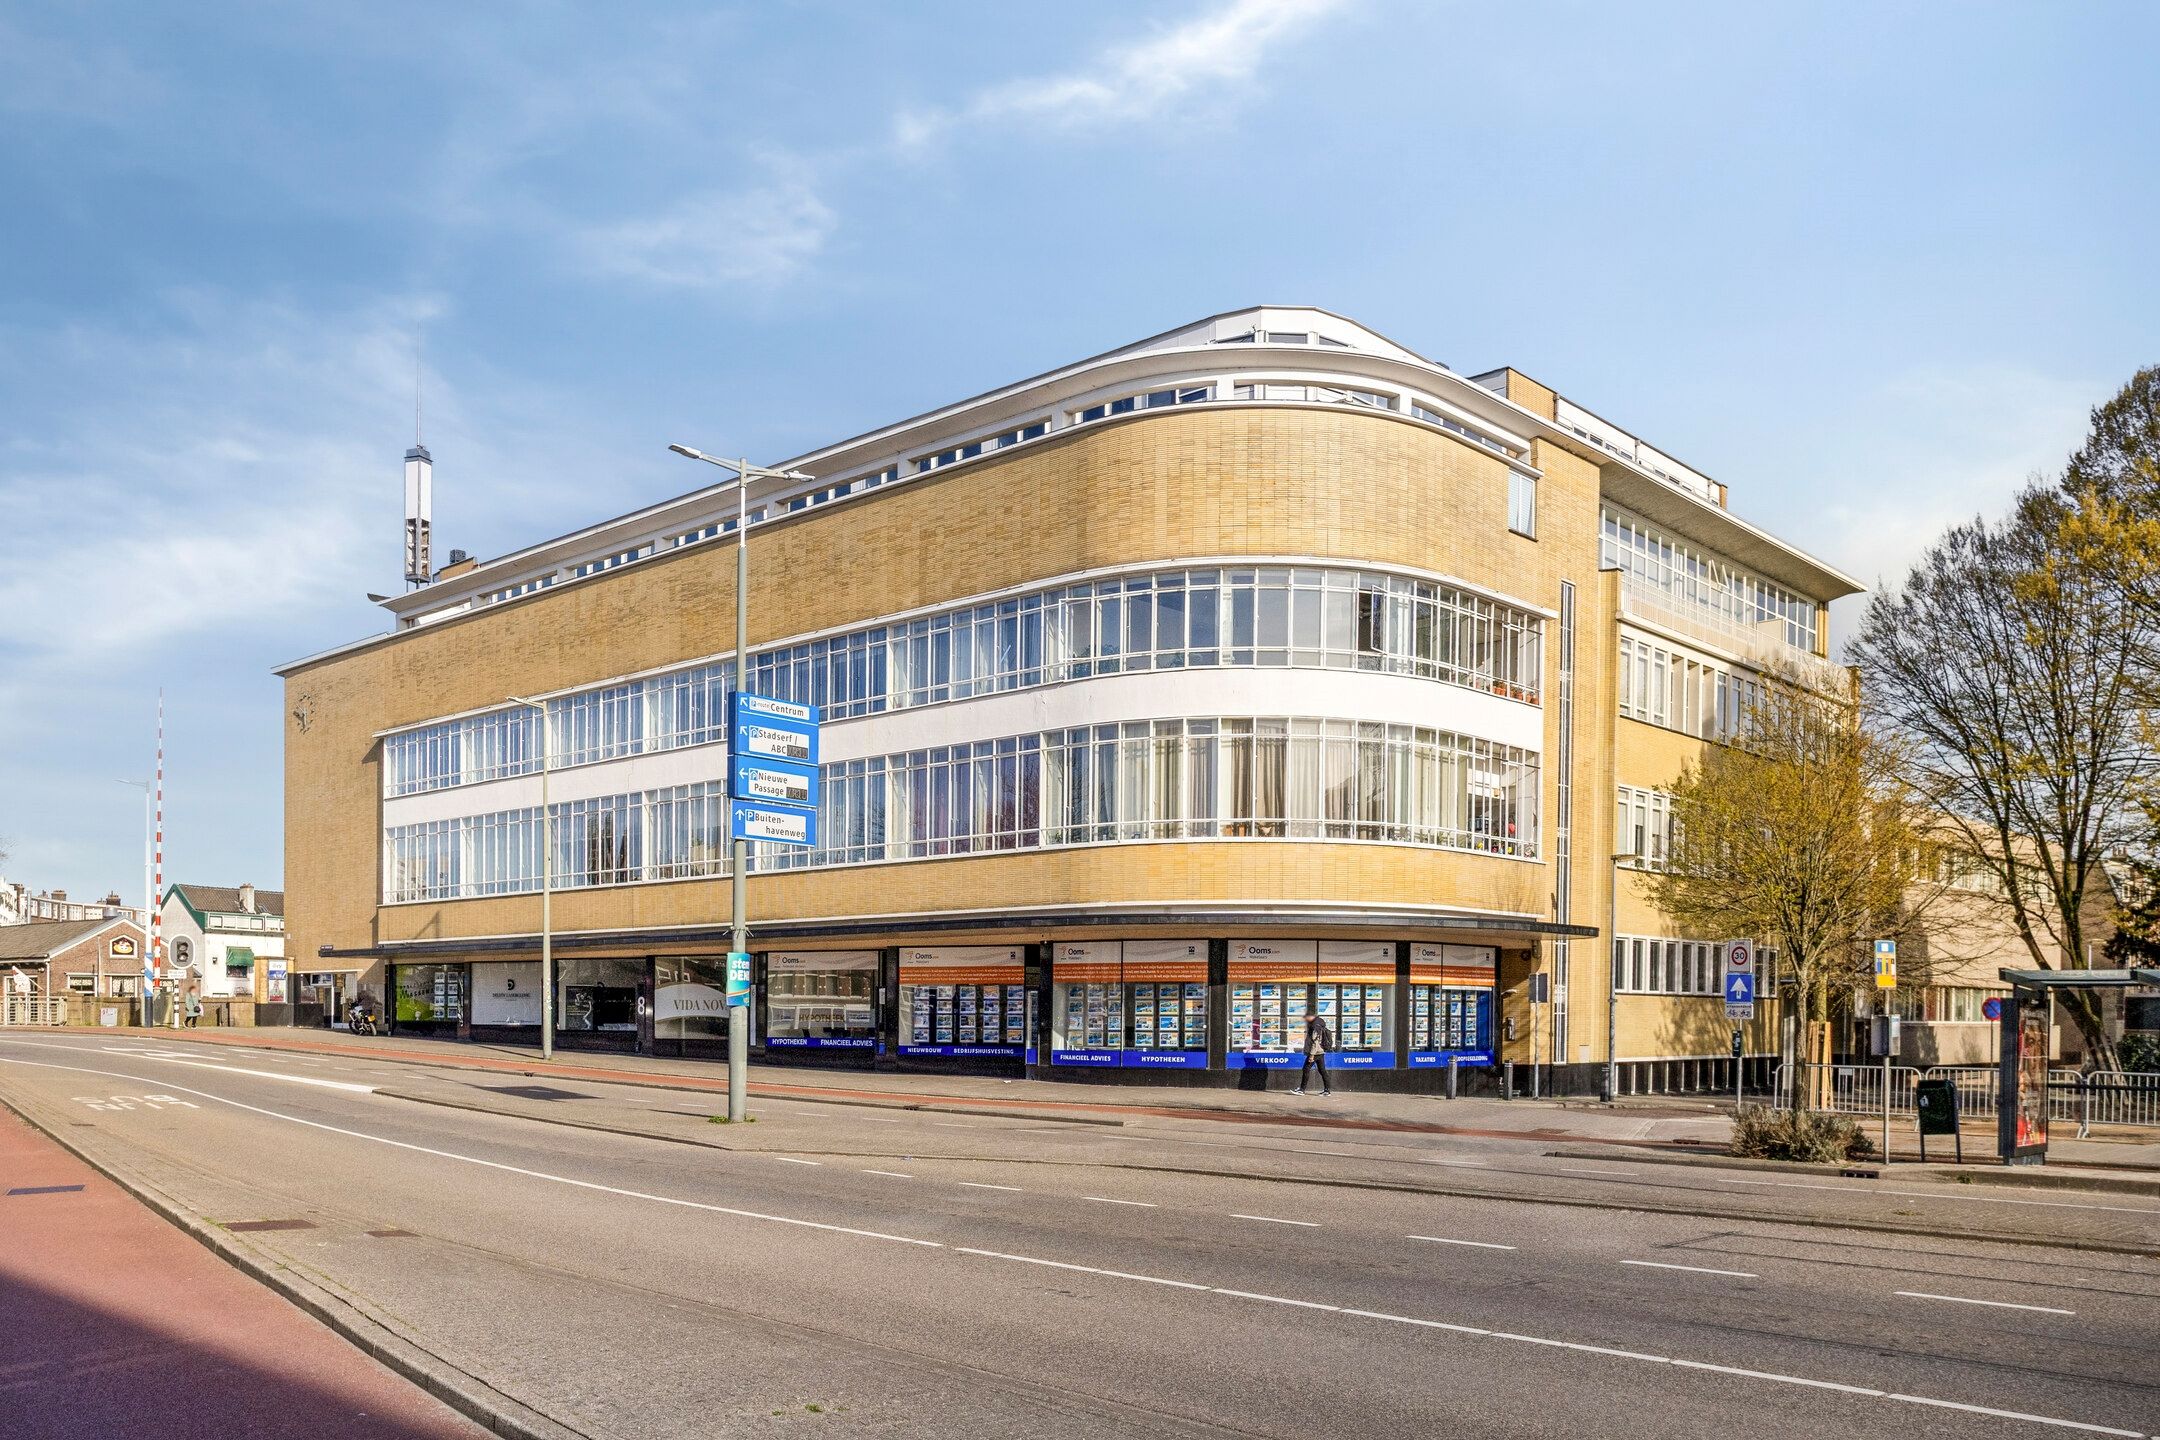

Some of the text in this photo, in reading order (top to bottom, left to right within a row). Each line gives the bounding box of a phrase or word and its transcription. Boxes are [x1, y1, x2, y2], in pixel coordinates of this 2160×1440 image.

[770, 703, 804, 717] Centrum
[758, 729, 793, 743] Stadserf
[771, 744, 787, 754] ABC
[758, 772, 788, 784] Nieuwe
[754, 783, 784, 797] Passage
[755, 812, 785, 824] Buiten-
[765, 825, 806, 840] havenweg
[1734, 952, 1745, 960] 30
[673, 999, 727, 1011] VIDA NOV
